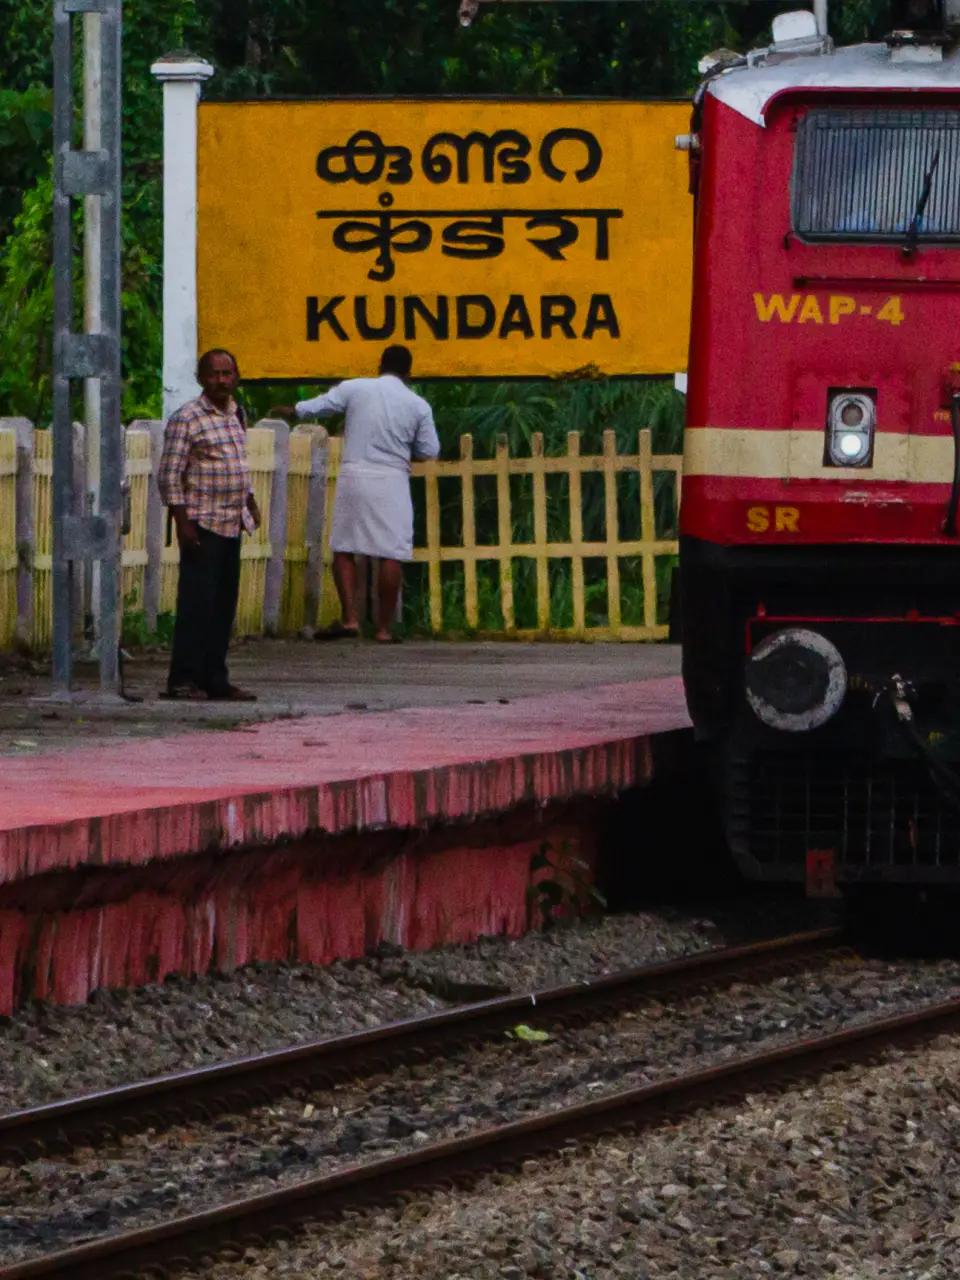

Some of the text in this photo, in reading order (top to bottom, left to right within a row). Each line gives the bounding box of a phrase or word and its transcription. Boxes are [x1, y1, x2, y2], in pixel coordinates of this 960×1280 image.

[316, 128, 602, 184] കുണ്ടറ
[316, 192, 623, 282] कुंडरा
[306, 294, 620, 342] KUNDARA
[754, 294, 905, 325] WAP-4
[746, 506, 800, 533] SR
